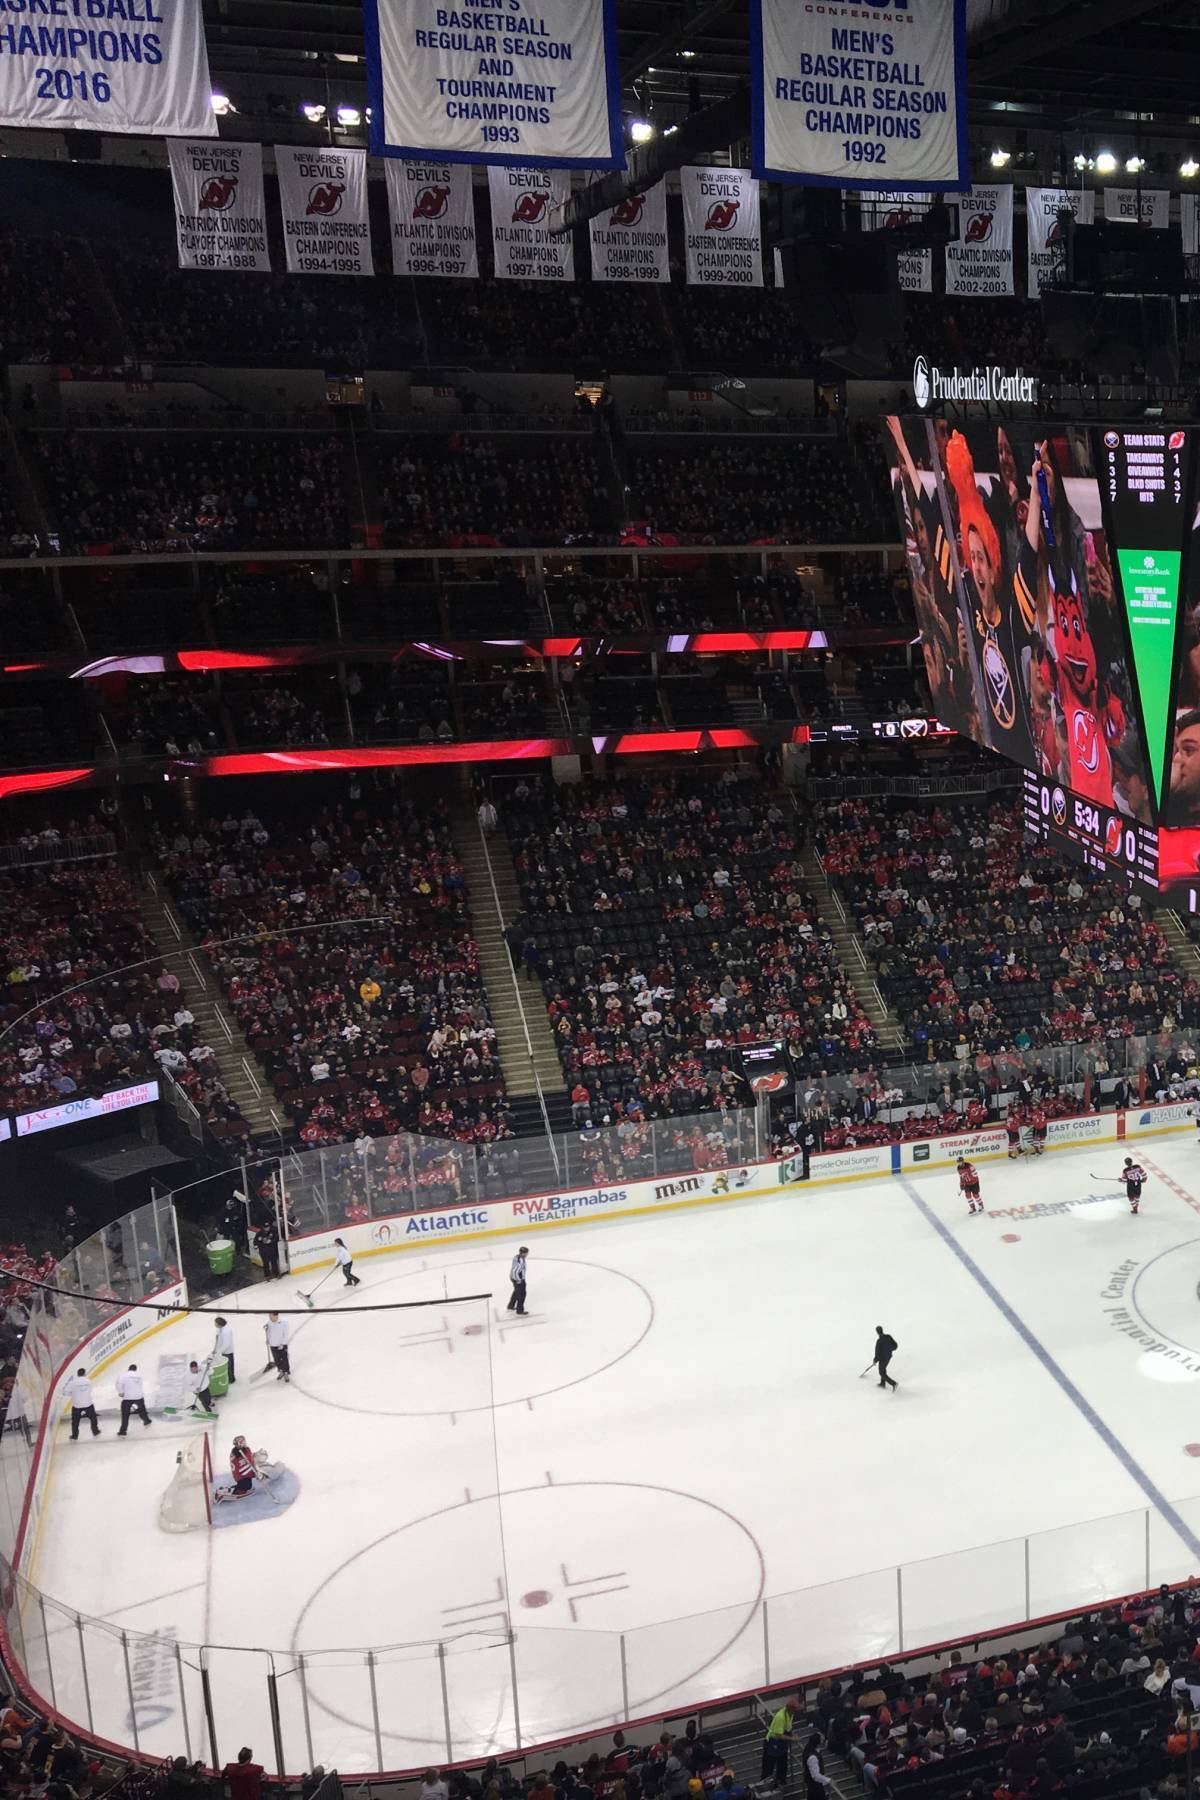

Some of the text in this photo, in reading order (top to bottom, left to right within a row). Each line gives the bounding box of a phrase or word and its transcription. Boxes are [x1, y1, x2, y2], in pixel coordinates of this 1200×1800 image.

[0, 0, 162, 23] ETBALL
[804, 4, 915, 24] CONFERENCE
[436, 9, 551, 37] BASKETBALL
[415, 29, 573, 61] REGULAR SEASON
[831, 27, 894, 56] MEN'S
[478, 58, 514, 77] AND
[800, 52, 925, 87] BASKETBALL
[35, 68, 111, 103] 2016
[436, 78, 557, 104] TOURNAMENT
[775, 77, 948, 114] REGULAR SEASON
[446, 101, 550, 124] CHAMPIONS
[805, 109, 922, 140] CHAMPIONS
[481, 126, 520, 143] 1993
[187, 146, 243, 157] NEW JERSEY
[294, 153, 348, 165] NEW JERSEY
[842, 140, 887, 164] 1992
[193, 158, 240, 173] DEVILS
[300, 164, 345, 179] DEVILS
[407, 168, 450, 182] DEVILS
[509, 173, 551, 188] DEVILS
[696, 172, 743, 184] NEW JERSEY
[701, 184, 740, 197] DEVILS
[962, 199, 996, 212] DEVILS
[179, 215, 263, 233] PATRICK DIVISION
[286, 220, 368, 238] EASTERN CONFERENCE
[394, 224, 474, 241] ATLANTIC DIVISION
[495, 227, 532, 243] ATLANTIC
[592, 231, 666, 247] ATLANTIC DIVISION
[218, 236, 265, 252] CHAMPIONS
[296, 240, 360, 256] CHAMPIONS
[410, 242, 461, 258] CHAMPIONS
[688, 235, 760, 252] EASTERN CONFERENCE
[192, 254, 257, 268] 1987-1988
[509, 245, 558, 262] CHAMPIONS
[607, 249, 654, 264] CHAMPIONS
[697, 253, 753, 268] CHAMPIONS
[298, 258, 361, 272] 1994-1995
[406, 259, 467, 274] 1996-1997
[506, 263, 564, 278] 1997-1998
[604, 266, 660, 279] 1998-1999
[959, 265, 1001, 279] CHAMPIONS
[698, 270, 753, 283] 1999-2000
[953, 280, 1007, 293] 2002-2003
[932, 366, 1035, 403] Prudential Center
[1123, 434, 1165, 447] TEAM STATS
[1108, 451, 1179, 464] 5 TAKEAWAYS 1
[1109, 465, 1116, 477] 3
[1173, 467, 1181, 478] 4
[1109, 479, 1116, 490] 2
[1174, 480, 1181, 491] 3
[1110, 491, 1181, 504] 7 HITS 7
[1041, 786, 1050, 816] 0
[1074, 800, 1100, 837] 5:34
[1125, 829, 1136, 863] 0
[64, 1100, 92, 1115] ONE
[1049, 1119, 1101, 1133] EAST COAST
[940, 1132, 1007, 1149] STREAM GAMES
[948, 1148, 962, 1158] LIVE
[835, 1154, 880, 1169] Oral Surgery
[405, 1208, 489, 1235] Atlantic
[1099, 1258, 1141, 1300] Center
